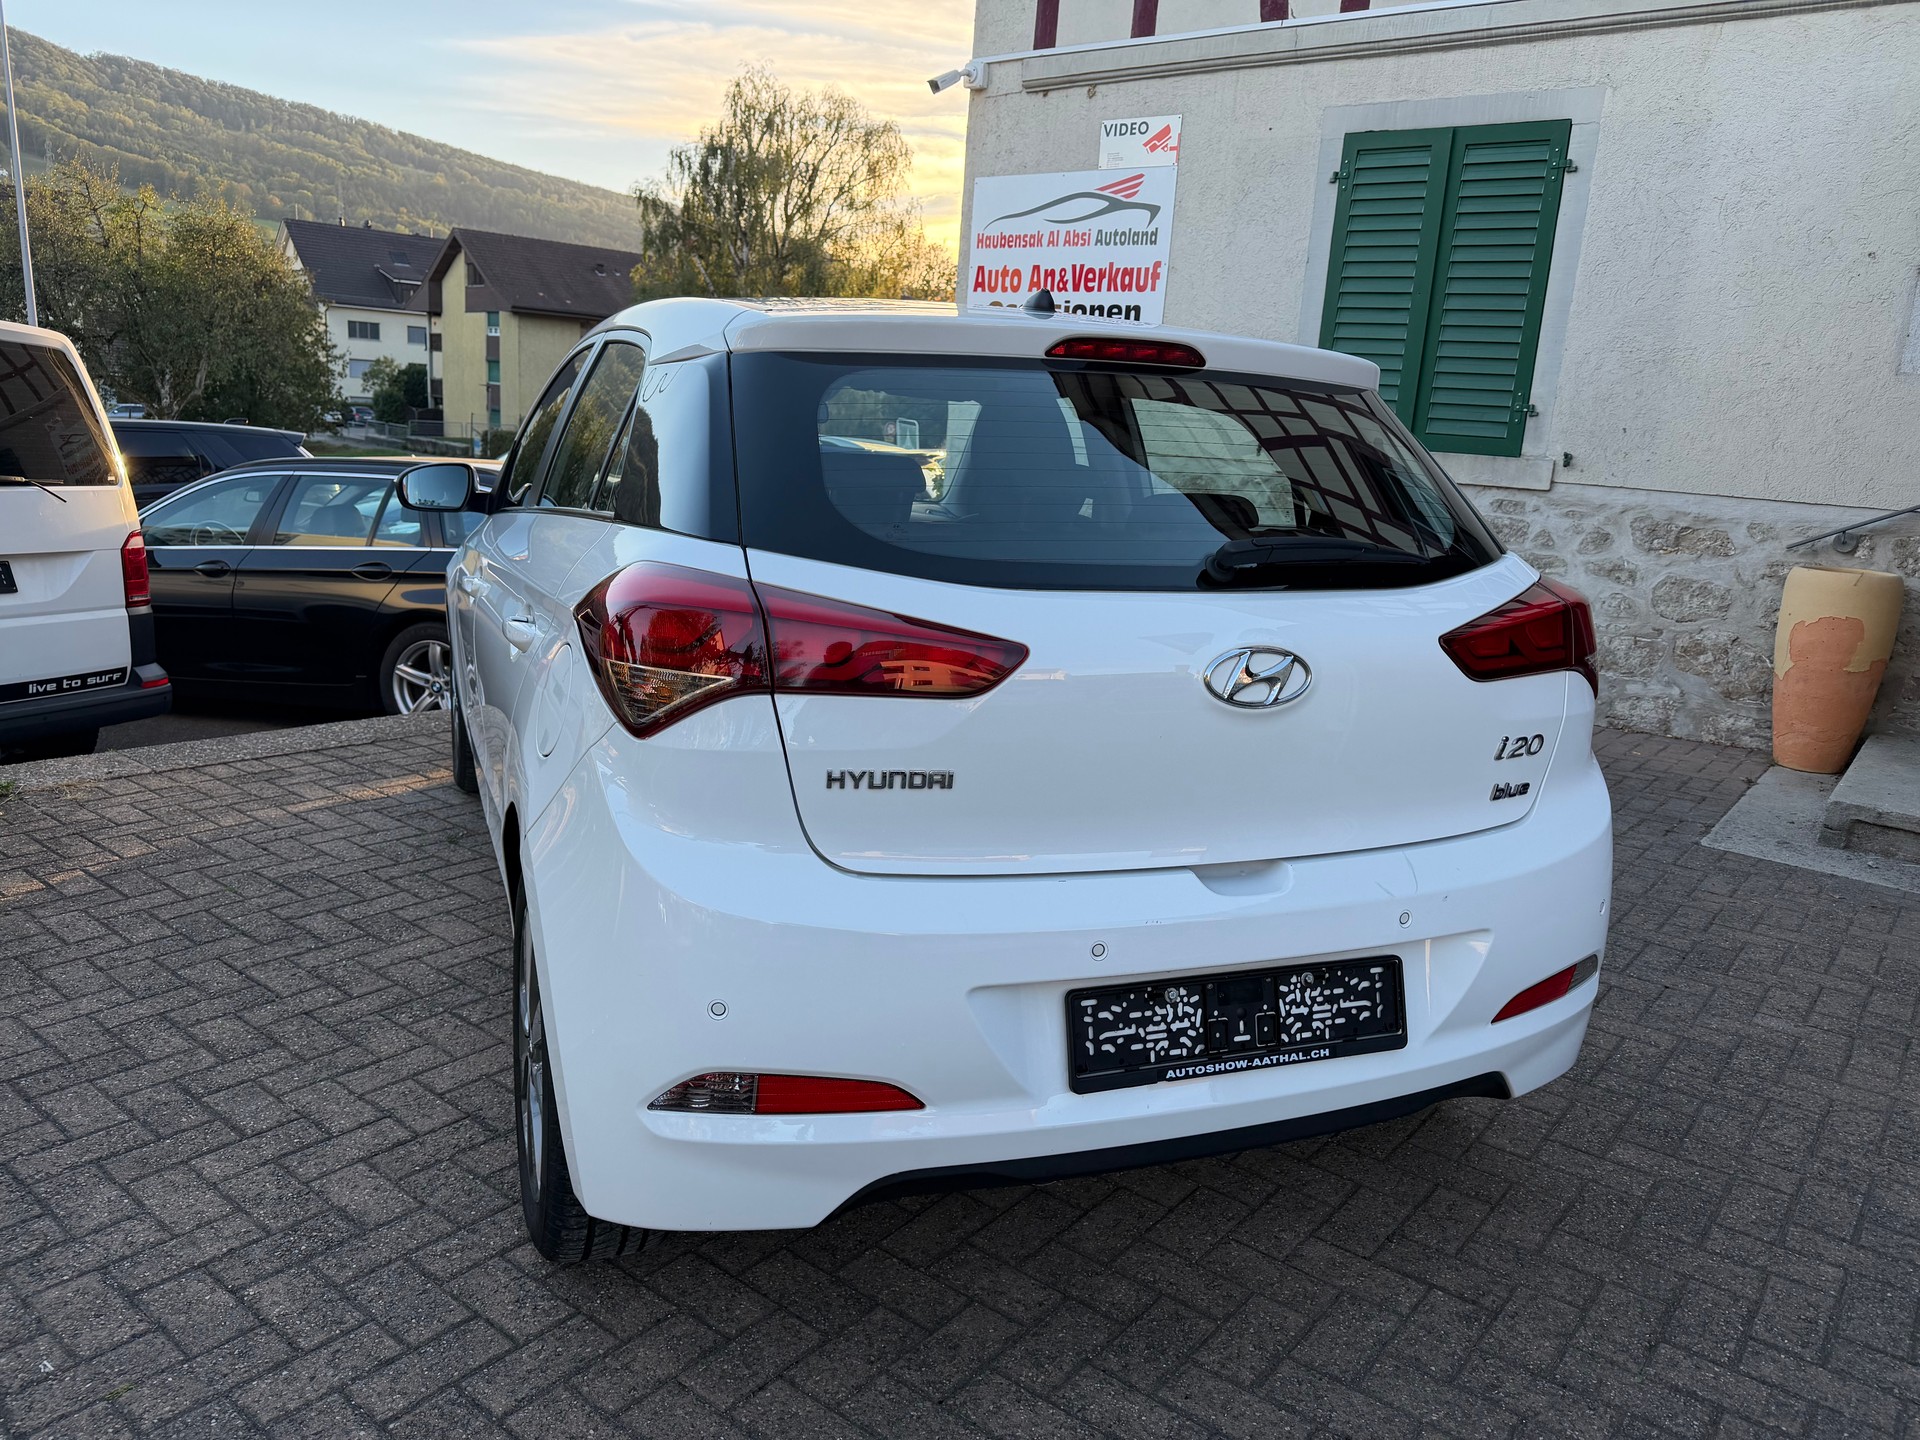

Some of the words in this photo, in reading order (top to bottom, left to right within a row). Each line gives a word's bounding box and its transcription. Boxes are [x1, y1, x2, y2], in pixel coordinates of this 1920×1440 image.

[1104, 121, 1149, 137] VIDEO
[976, 231, 1044, 249] Haubensak
[1047, 230, 1060, 247] Al
[1063, 229, 1092, 247] Absi
[1094, 227, 1159, 246] Autoland
[973, 265, 1022, 293] Auto
[1028, 261, 1162, 293] An&Verkauf
[28, 683, 57, 694] live
[63, 679, 82, 689] to
[1494, 733, 1545, 761] i20
[826, 768, 954, 790] HYUNDAI
[1489, 782, 1530, 801] blue
[1165, 1048, 1330, 1079] AUTOSHOW-AATHAL.CH
